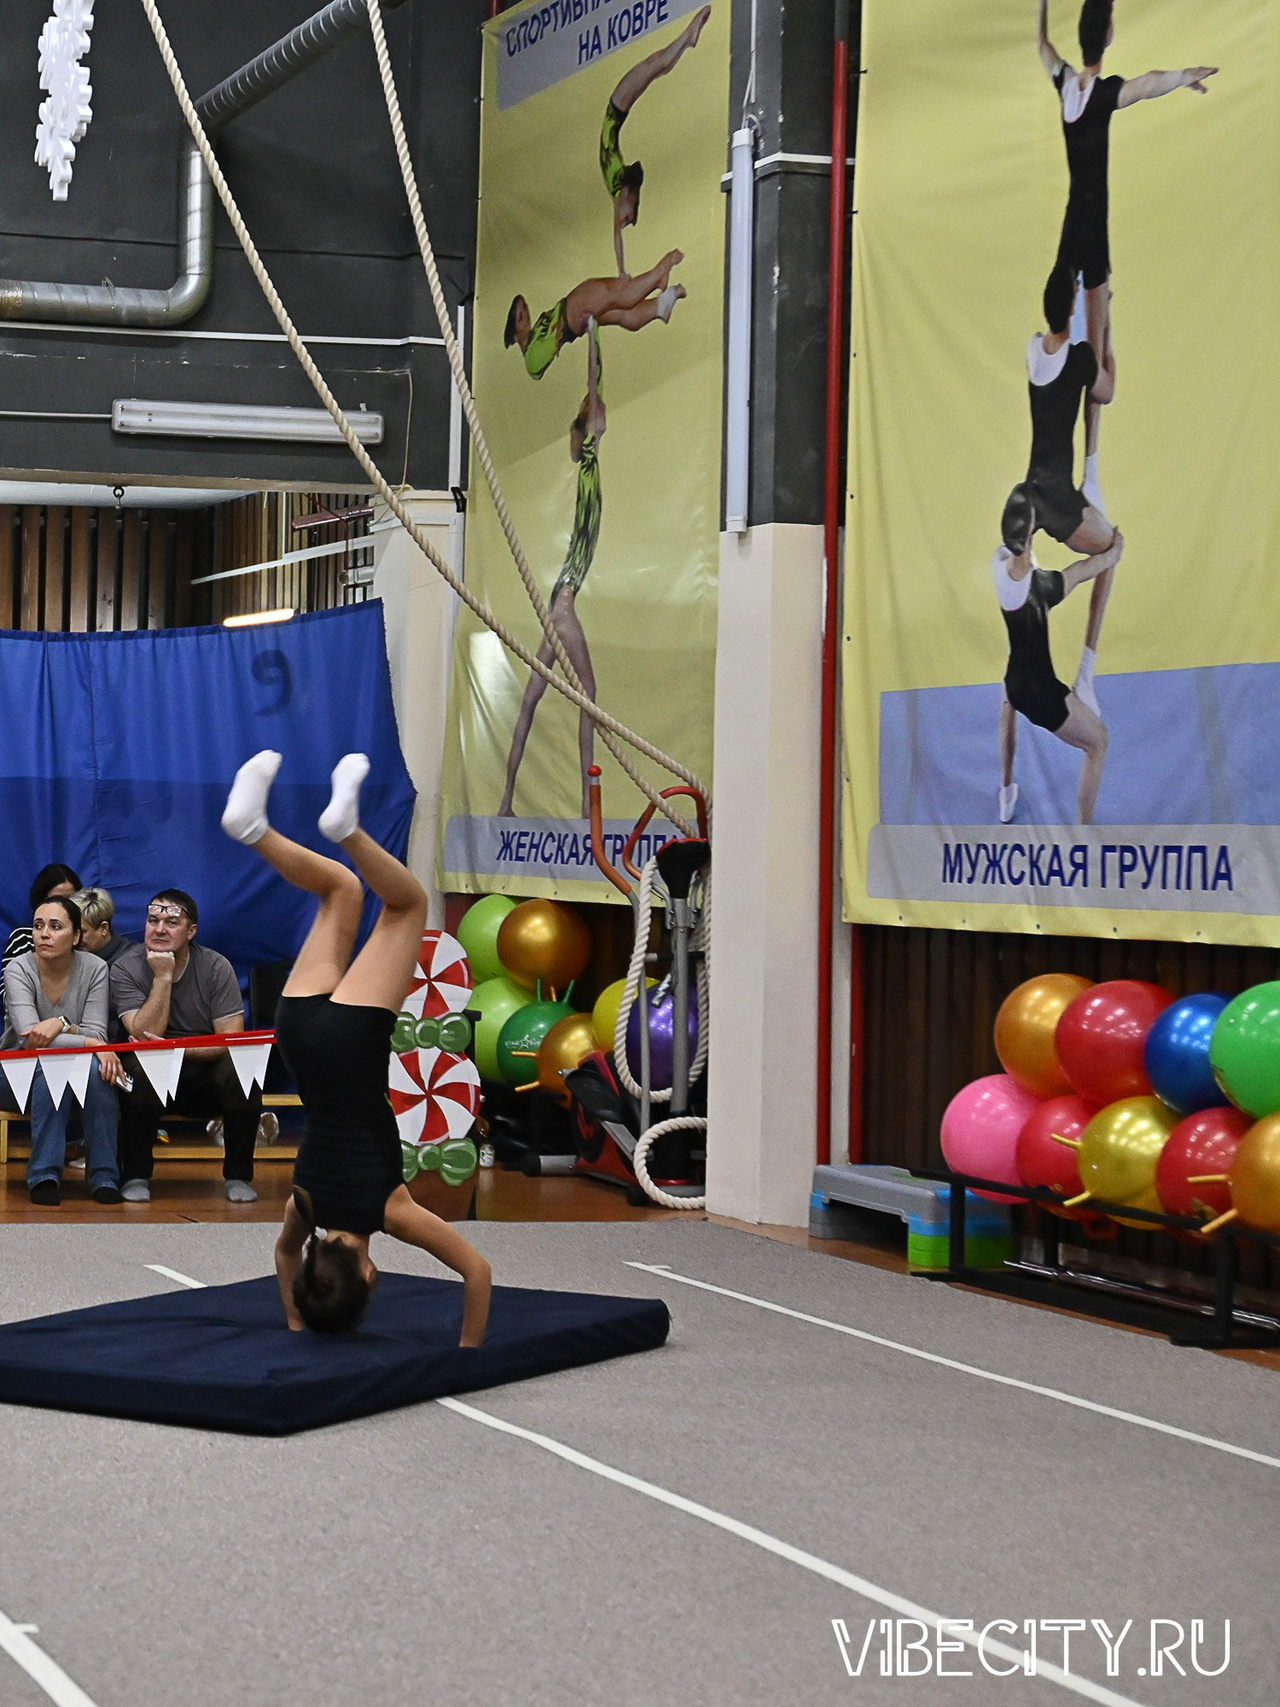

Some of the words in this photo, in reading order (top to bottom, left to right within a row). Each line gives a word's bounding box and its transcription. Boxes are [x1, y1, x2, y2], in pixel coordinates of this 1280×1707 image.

[577, 25, 602, 65] НА
[606, 0, 669, 51] КОВРЕ
[496, 830, 594, 867] ЖЕНСКАЯ
[602, 833, 678, 868] ГРПП
[941, 843, 1089, 888] МУЖСКАЯ
[1100, 844, 1234, 891] ГРУППА
